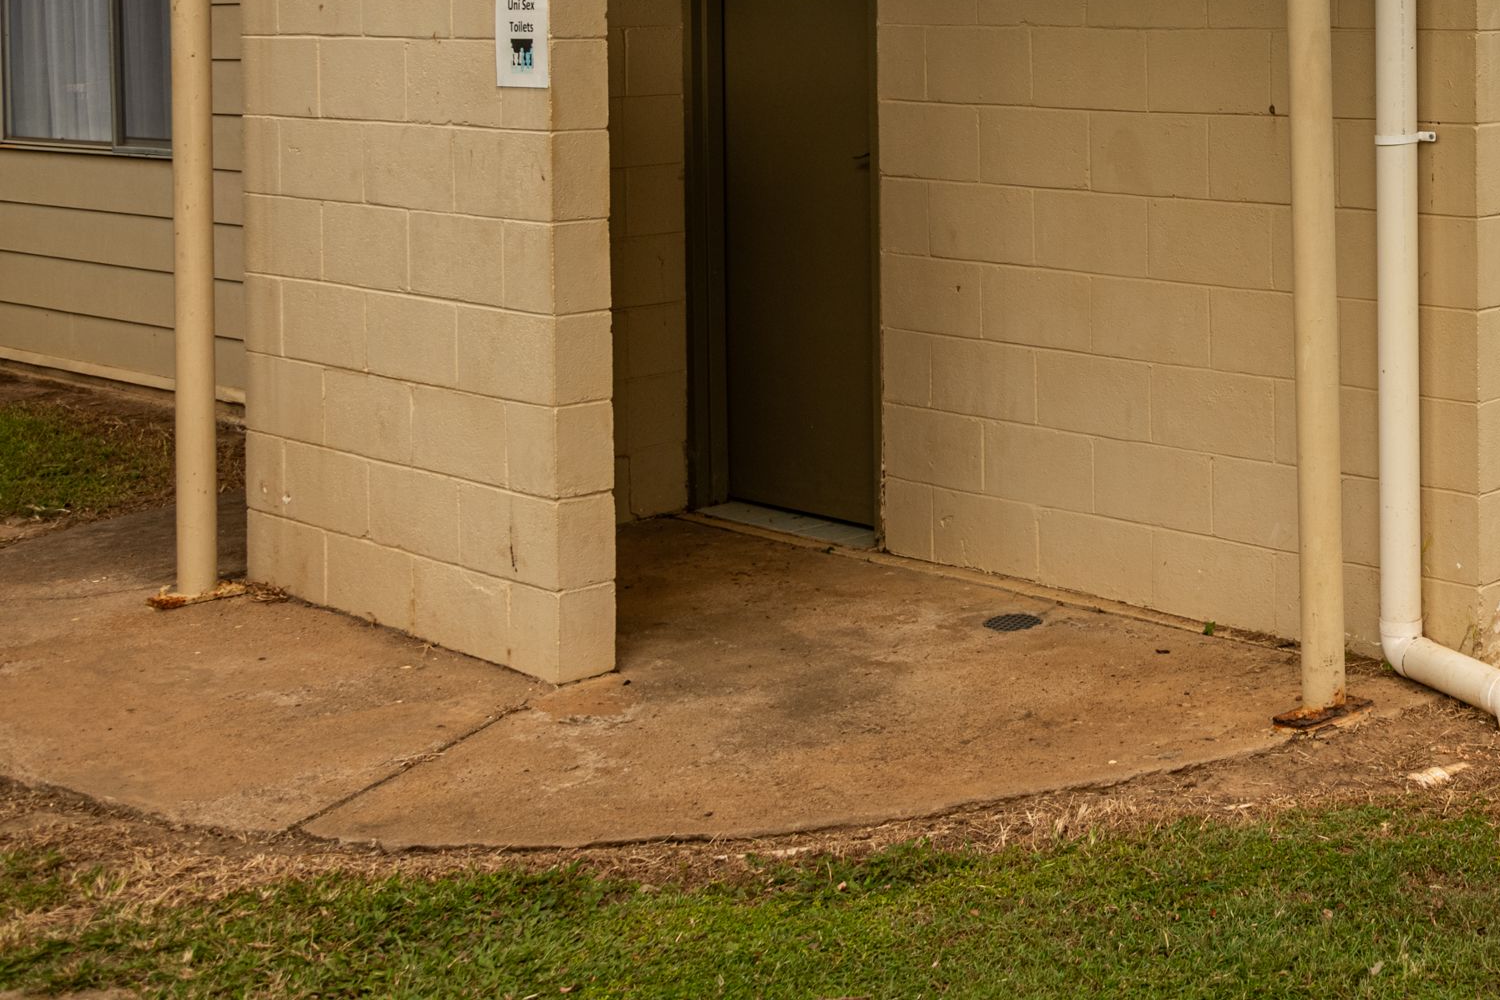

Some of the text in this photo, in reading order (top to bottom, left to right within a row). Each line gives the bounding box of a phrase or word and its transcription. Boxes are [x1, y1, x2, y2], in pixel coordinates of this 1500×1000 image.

[507, 0, 535, 10] Uni Sex
[509, 21, 534, 32] Toilets
